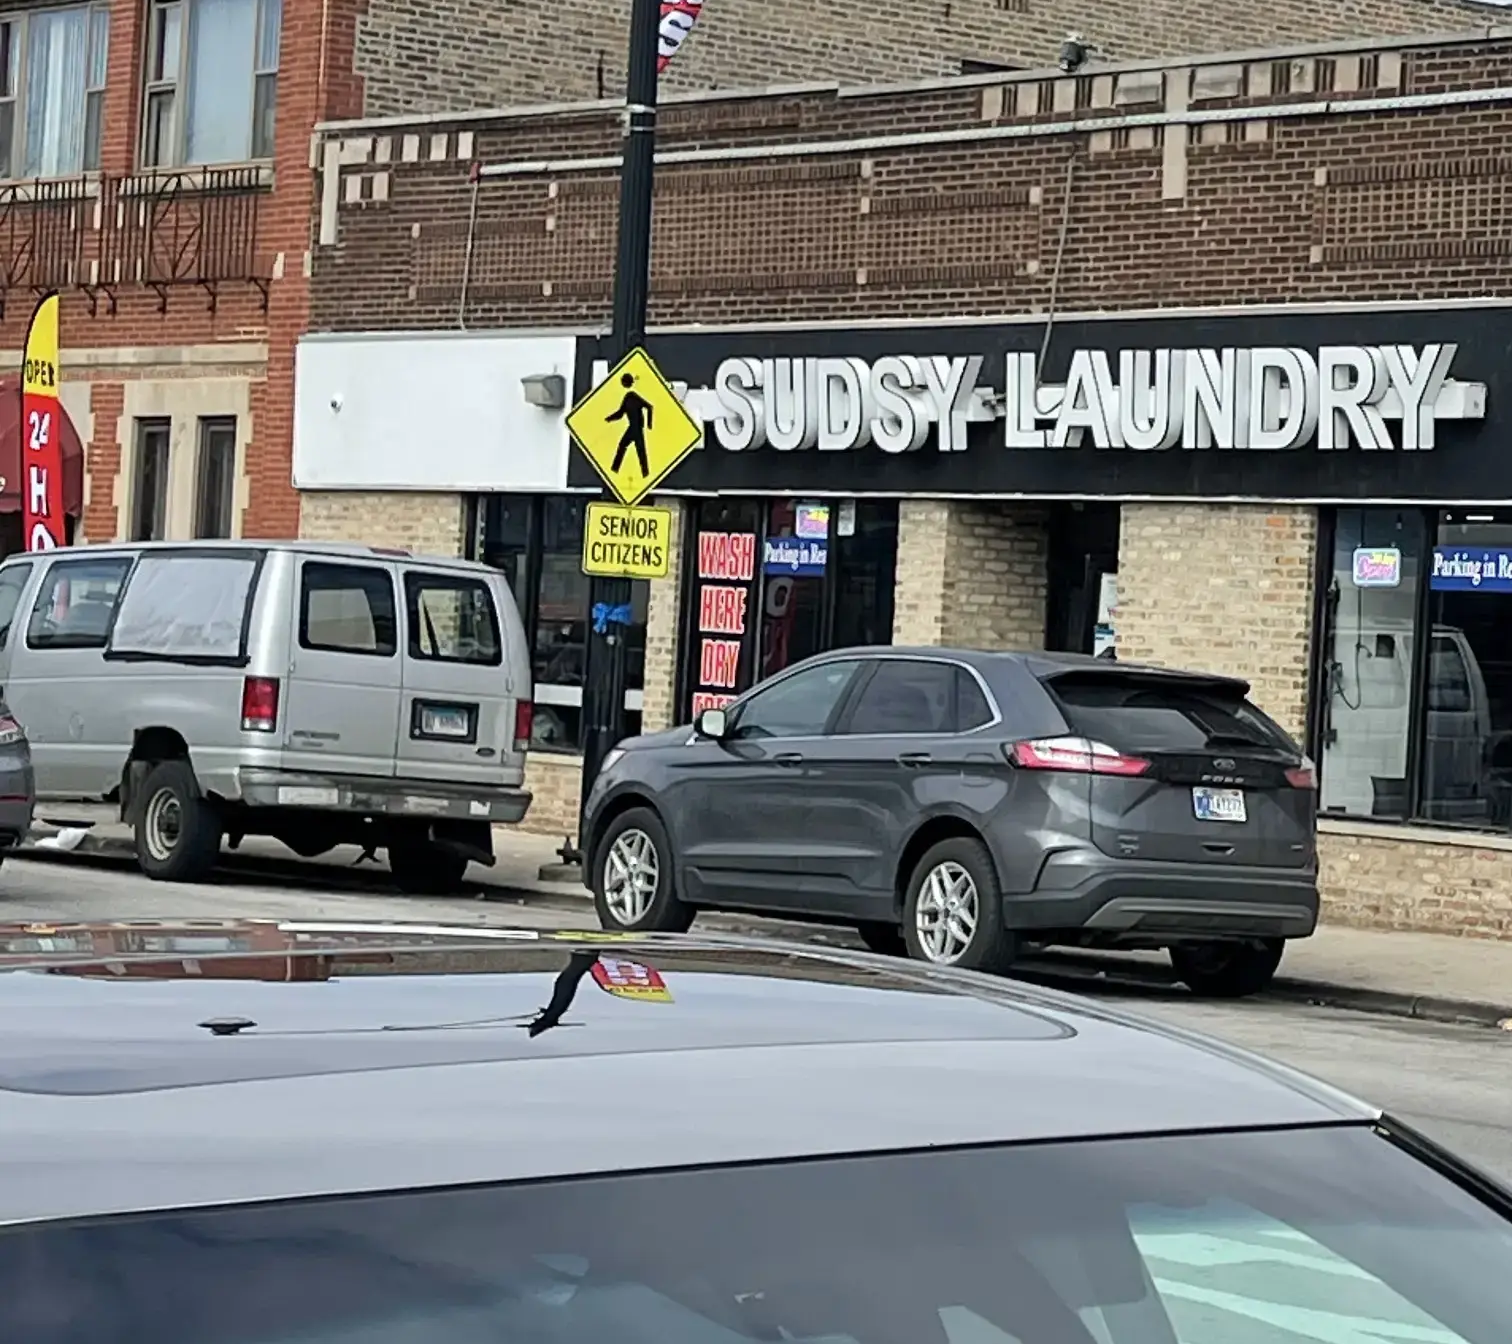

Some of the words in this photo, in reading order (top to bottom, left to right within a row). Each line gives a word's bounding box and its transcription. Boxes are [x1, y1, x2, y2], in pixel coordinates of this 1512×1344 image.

[714, 355, 984, 453] SUDSY
[1005, 342, 1457, 451] LAUNDRY
[28, 409, 51, 451] 24
[600, 514, 658, 540] SENIOR
[591, 541, 662, 567] CITIZENS
[699, 531, 756, 581] WASH
[1432, 552, 1481, 586] Parking
[1483, 553, 1496, 578] in
[699, 585, 748, 635] HERE
[700, 639, 741, 689] DRY
